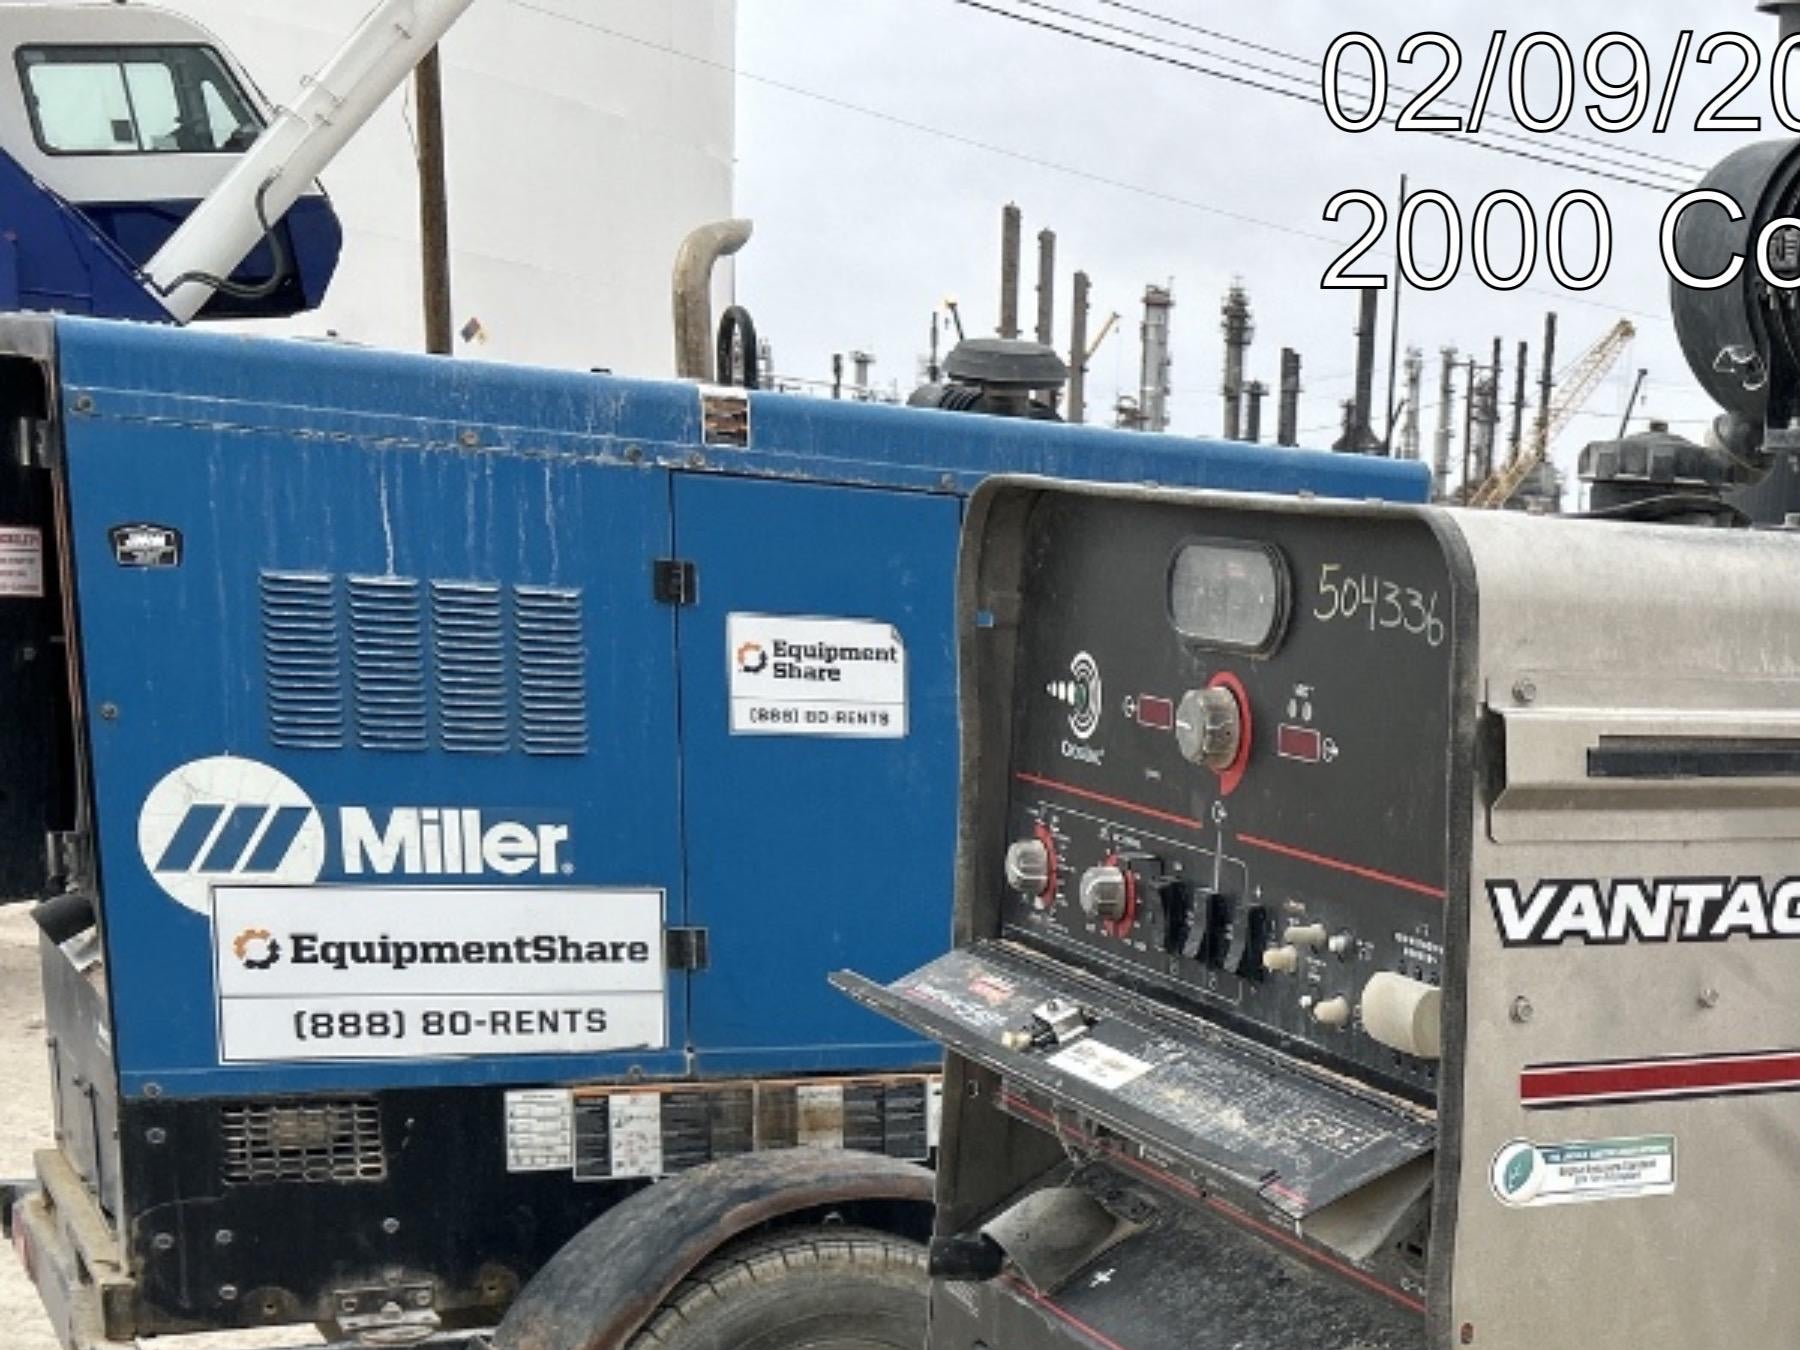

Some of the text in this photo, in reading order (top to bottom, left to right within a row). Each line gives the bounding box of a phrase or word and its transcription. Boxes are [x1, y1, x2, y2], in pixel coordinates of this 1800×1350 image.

[1312, 563, 1444, 646] 504336
[772, 639, 898, 664] Equipment
[773, 661, 842, 682] Share
[289, 932, 650, 969] EquipmentShare
[293, 1008, 608, 1040] (888) 80-RENTS
